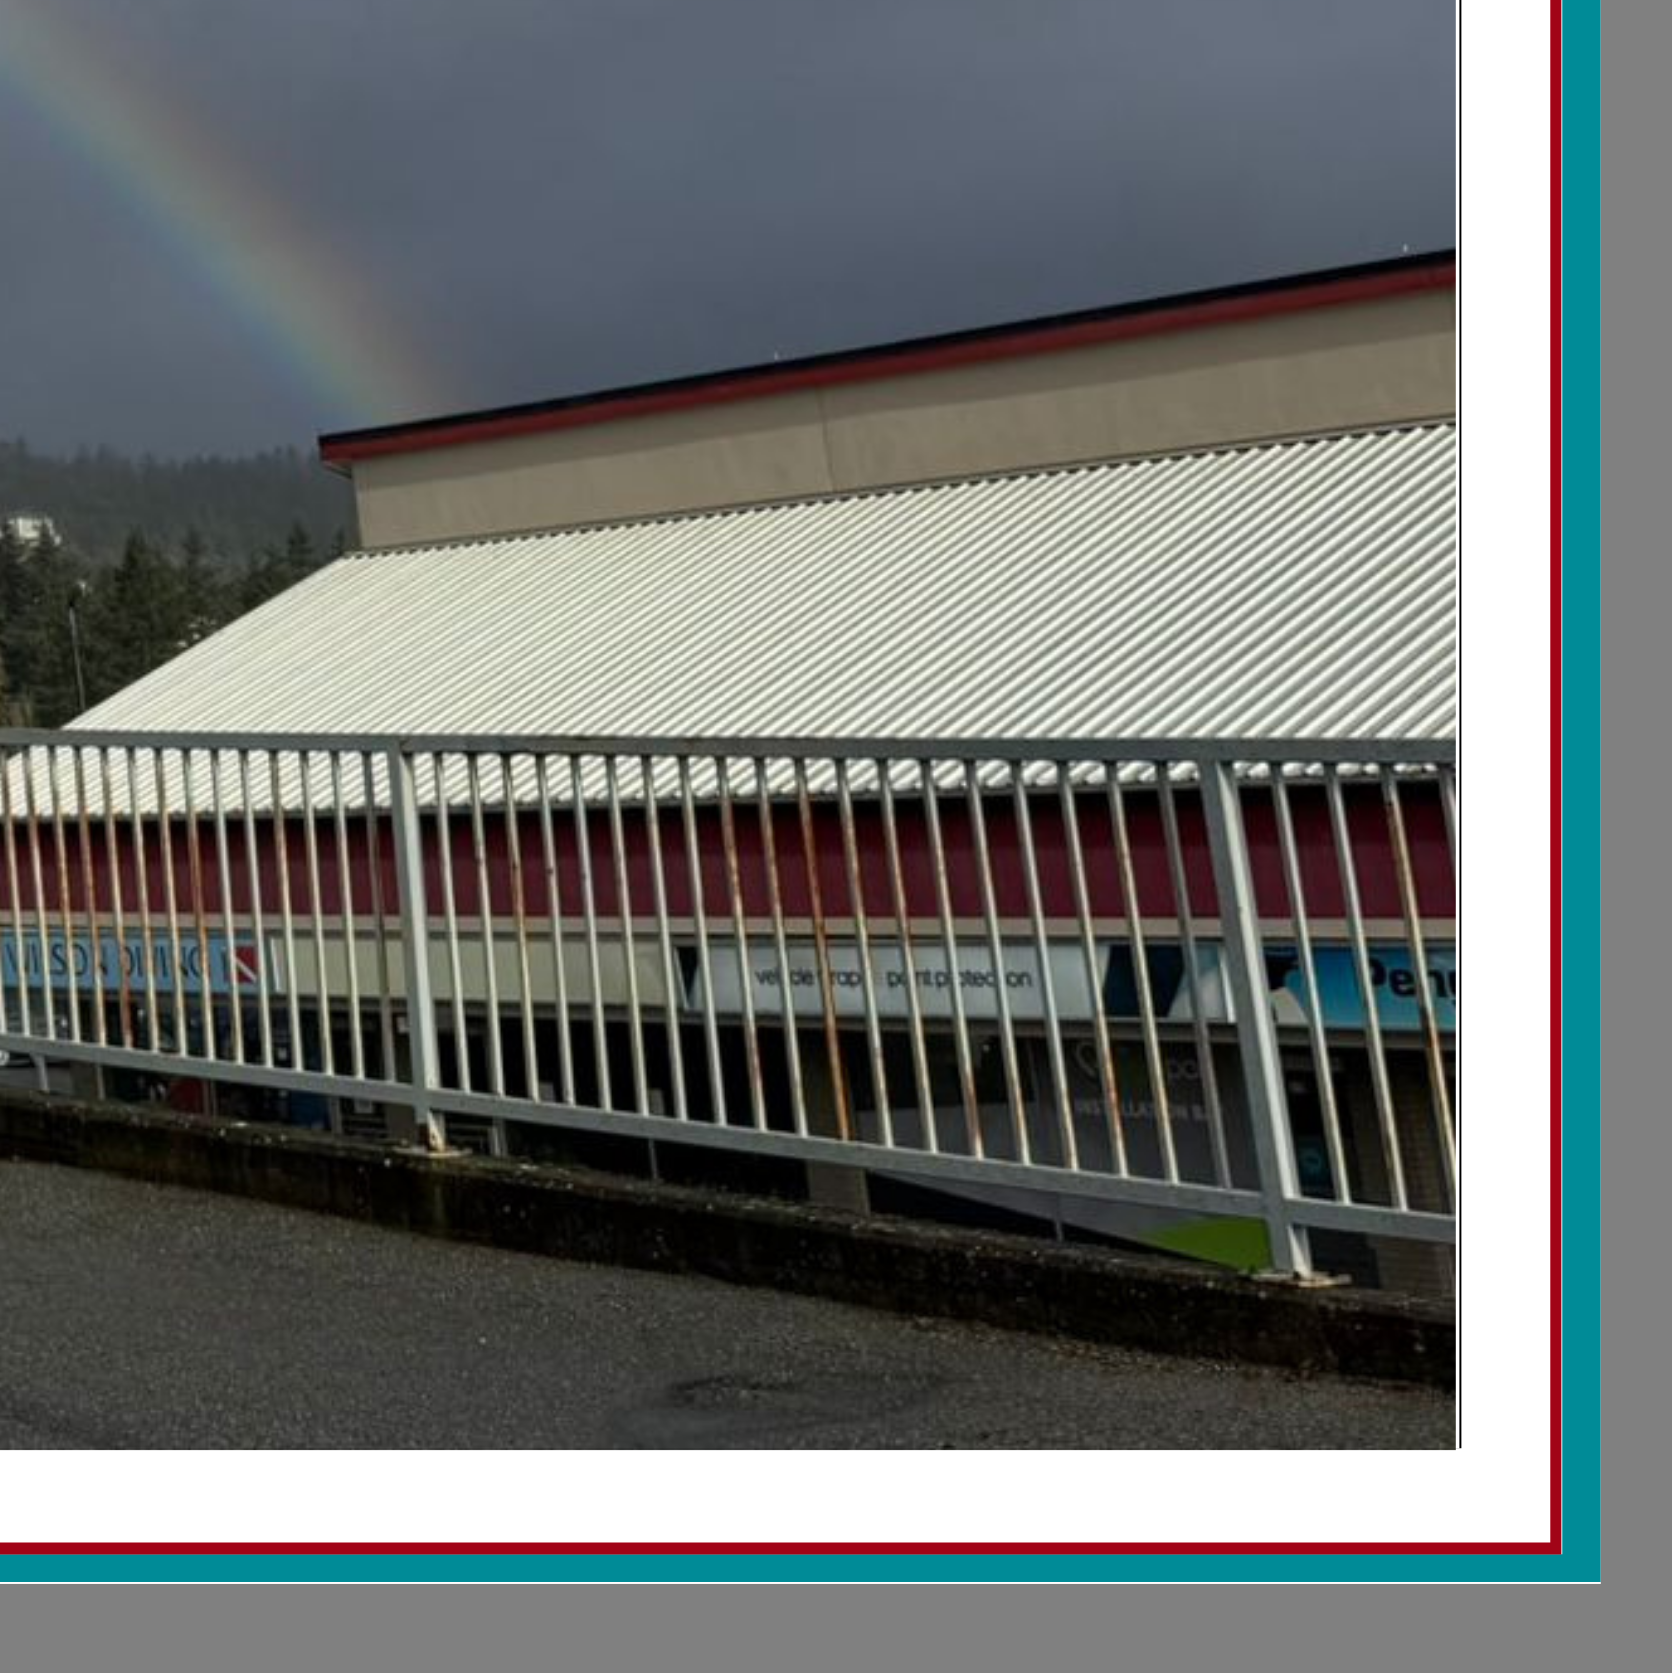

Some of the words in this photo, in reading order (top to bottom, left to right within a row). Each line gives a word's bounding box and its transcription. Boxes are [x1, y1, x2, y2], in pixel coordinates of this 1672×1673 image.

[1, 942, 109, 977] WISON
[117, 944, 209, 979] DIING
[754, 967, 816, 986] vecle
[886, 967, 931, 990] pant
[935, 968, 1033, 991] potecon
[1353, 957, 1456, 1008] Pen
